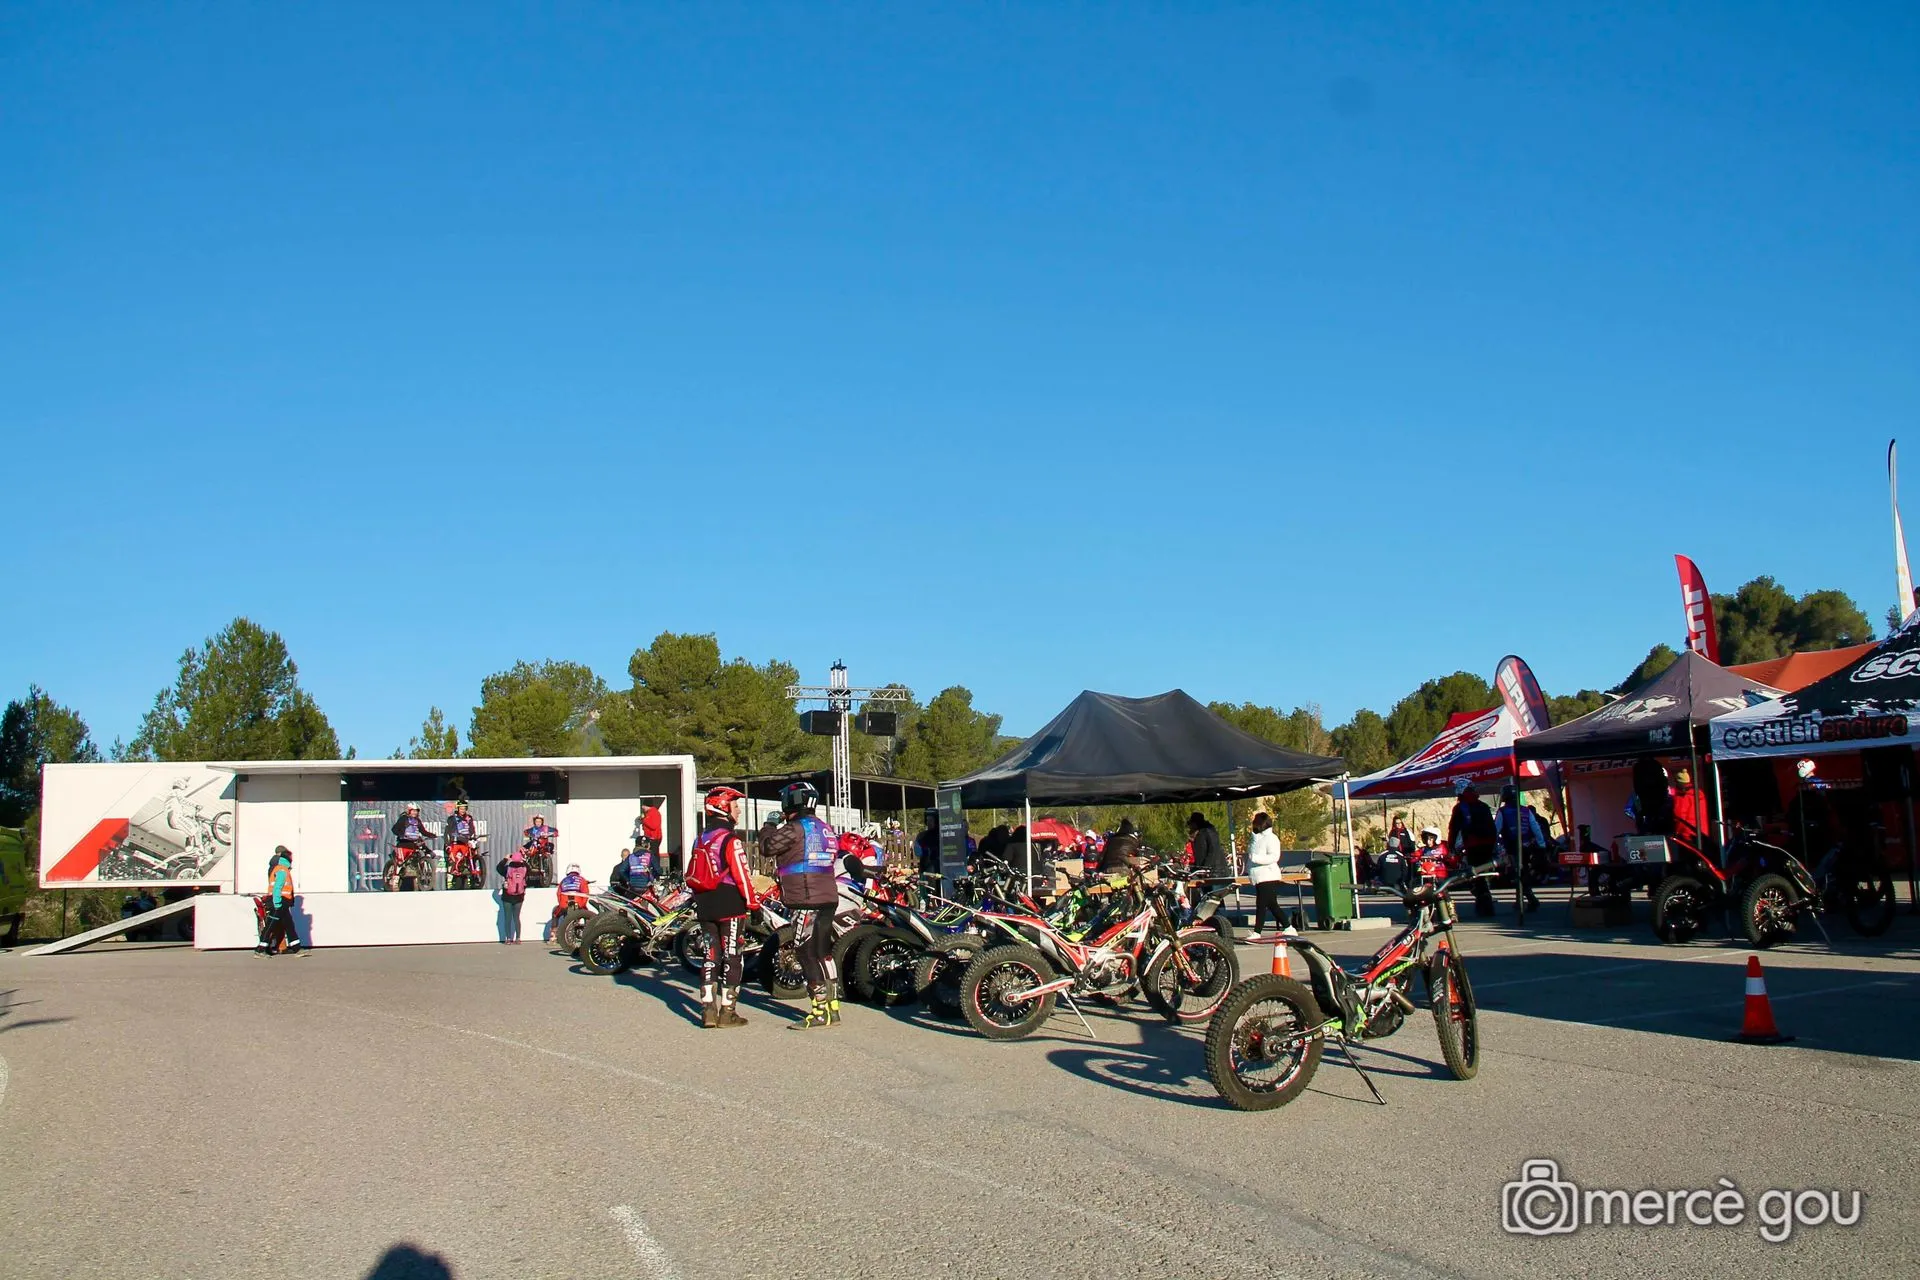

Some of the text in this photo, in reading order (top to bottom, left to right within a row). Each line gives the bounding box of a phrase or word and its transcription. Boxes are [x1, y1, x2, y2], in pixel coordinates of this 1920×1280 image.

[1856, 650, 1920, 679] SC
[1724, 711, 1908, 749] scottish enduro
[423, 821, 444, 836] RIAL
